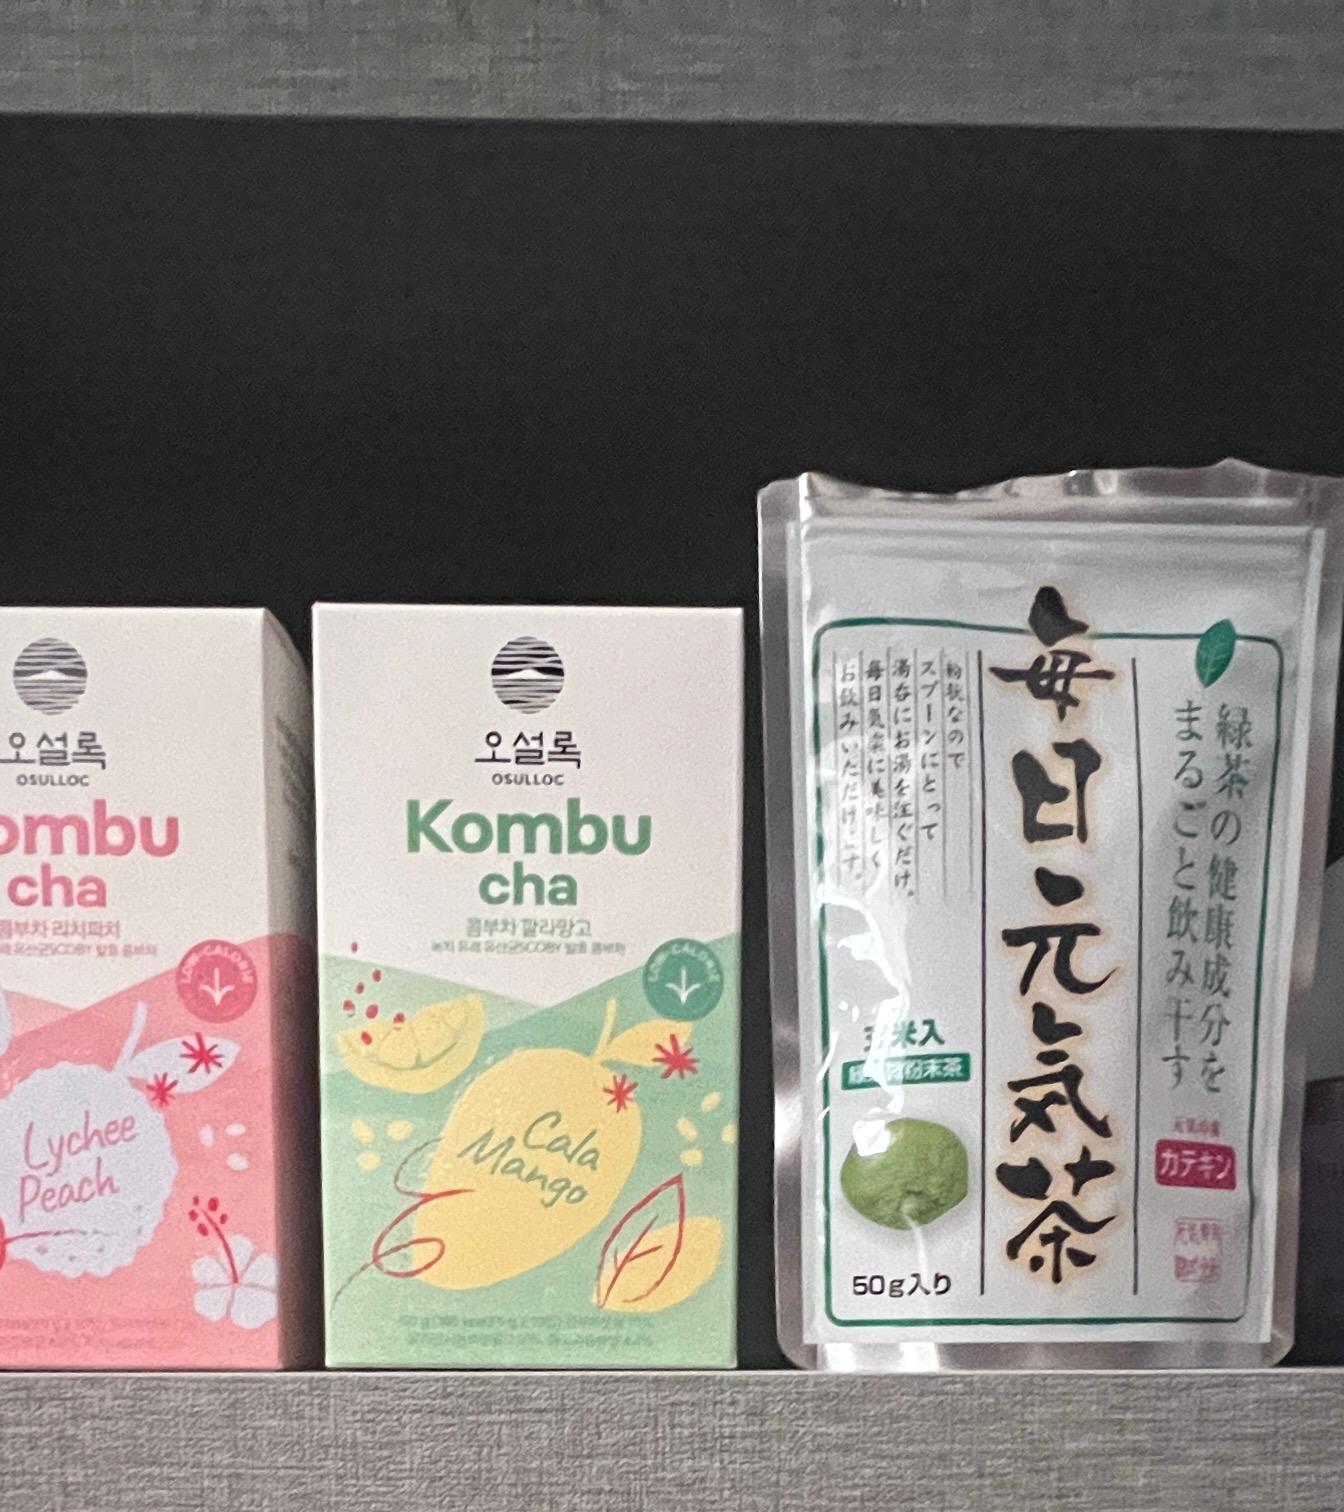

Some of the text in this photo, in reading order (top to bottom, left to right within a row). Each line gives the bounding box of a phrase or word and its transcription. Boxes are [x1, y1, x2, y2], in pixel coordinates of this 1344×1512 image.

[475, 731, 581, 768] 오설록
[16, 774, 90, 787] OSULLOC
[492, 773, 564, 786] OSULLOC
[406, 797, 652, 856] Kombu
[7, 863, 107, 908] cha
[478, 862, 577, 906] cha
[1161, 700, 1205, 1090] まるごと飲み干す
[1197, 703, 1253, 1093] 緑茶の健康成分を
[466, 917, 517, 938] 콤부차
[988, 586, 1118, 1284] 毎日元気茶
[24, 1110, 137, 1176] Lychee
[523, 1110, 601, 1171] Cala
[1160, 1149, 1232, 1180] カテキン
[19, 1157, 119, 1224] Peach
[457, 1127, 588, 1209] Mango
[852, 1272, 952, 1298] 50g入り
